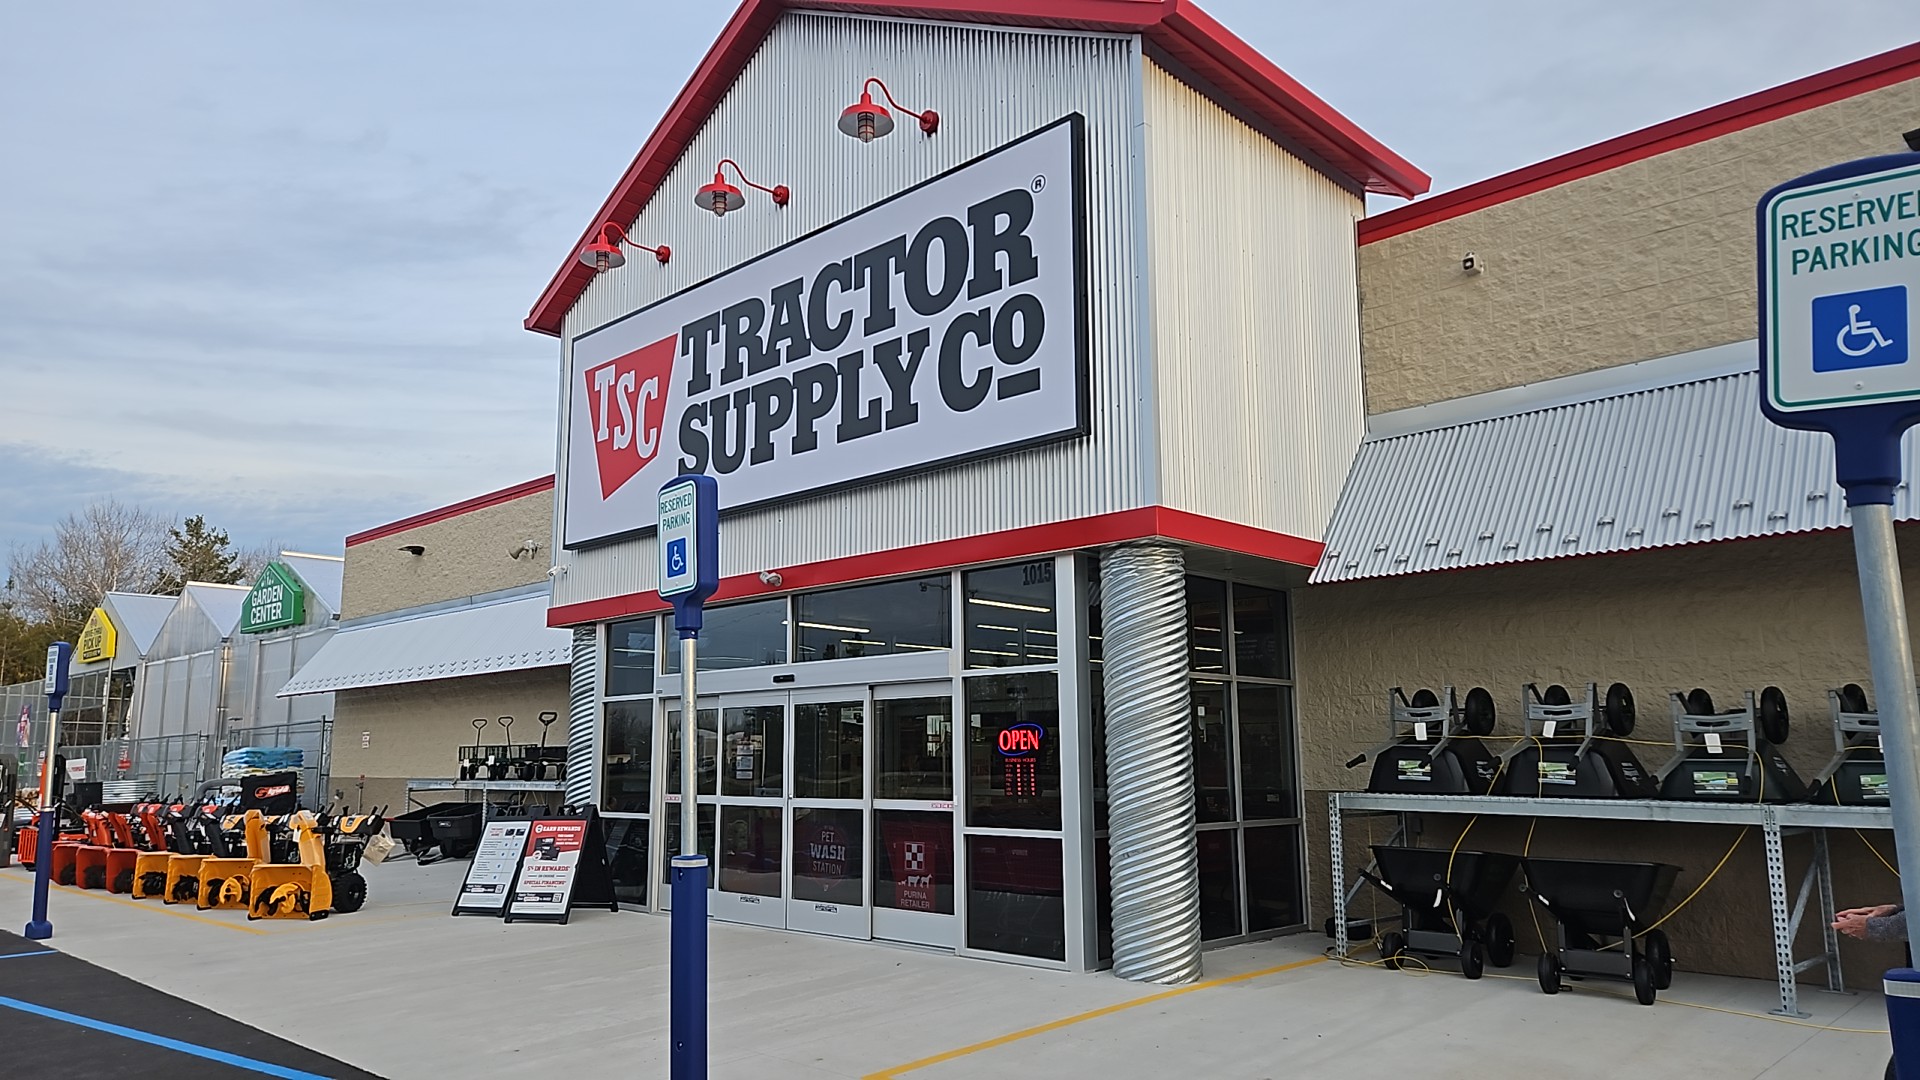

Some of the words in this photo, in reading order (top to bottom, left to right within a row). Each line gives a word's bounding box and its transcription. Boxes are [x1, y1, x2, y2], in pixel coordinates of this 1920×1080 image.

[1781, 189, 1920, 240] RESERVE
[1792, 228, 1920, 275] PARKING
[681, 188, 1039, 398] TRACTOR
[593, 363, 660, 460] TSC
[678, 326, 931, 475] SUPPLY
[660, 492, 692, 515] RESERVED
[662, 511, 691, 532] PARKING
[1022, 562, 1052, 586] 1015
[251, 583, 284, 607] GARDEN
[250, 602, 283, 625] CENTER
[83, 636, 95, 650] PICK
[95, 635, 102, 648] UP
[999, 730, 1039, 751] OPEN
[821, 831, 835, 843] PET
[809, 842, 846, 862] WASH
[812, 860, 842, 876] STATION
[900, 898, 930, 909] RETAILER
[903, 890, 927, 900] PURINA
